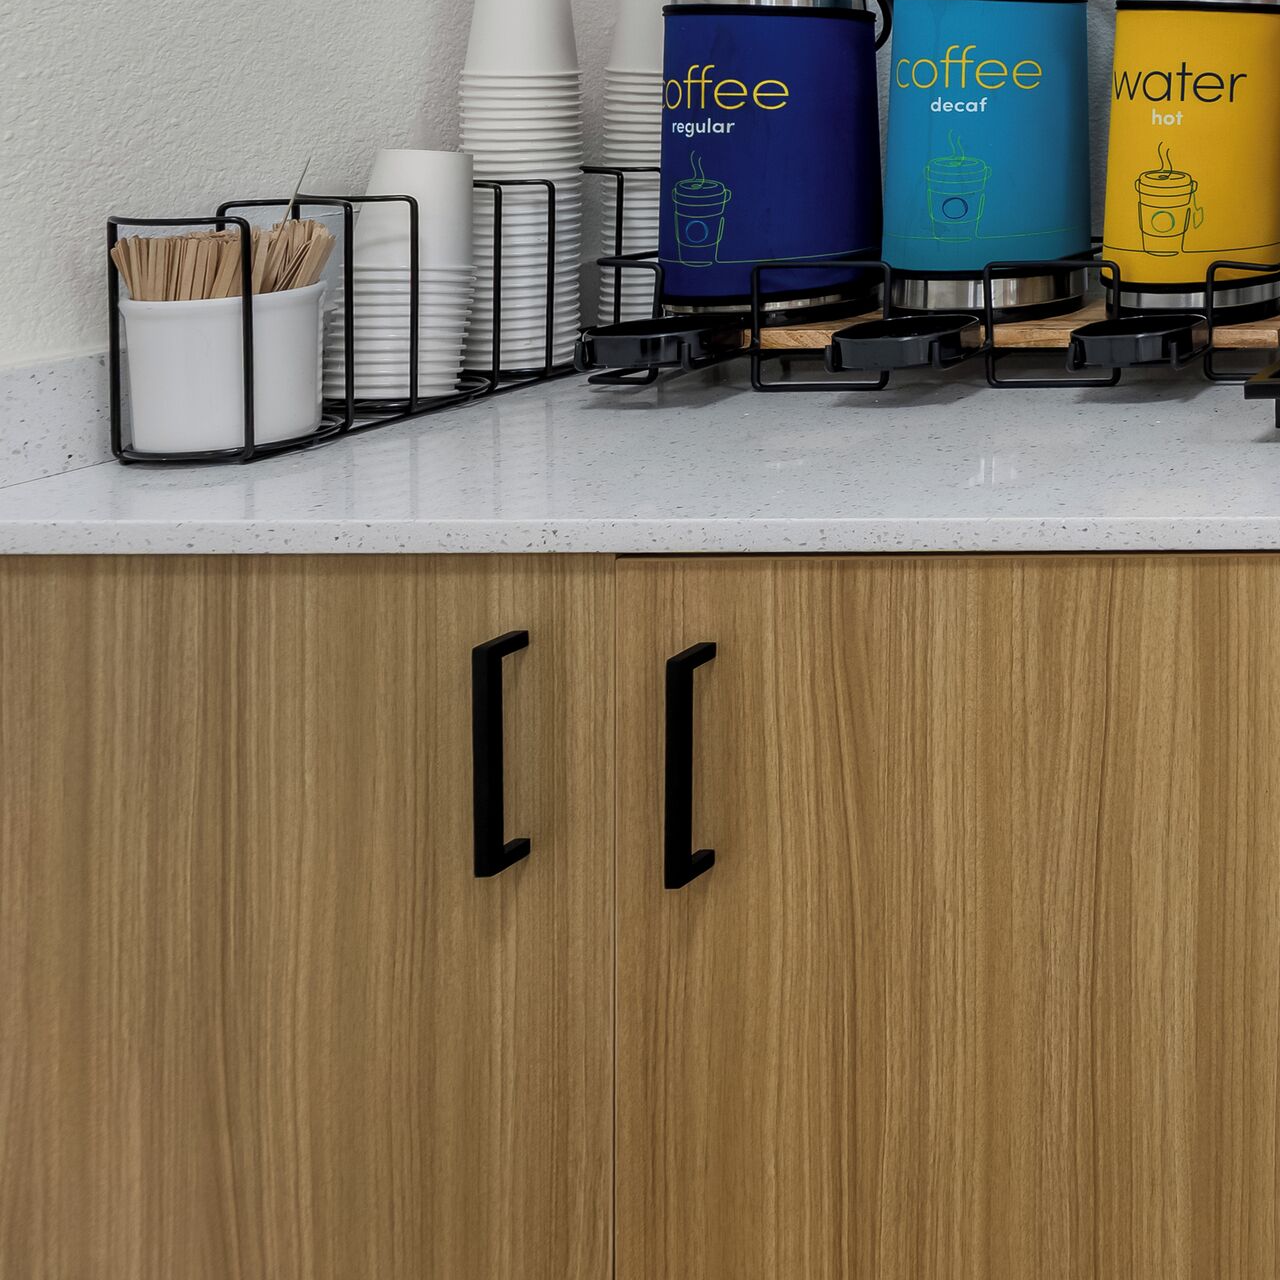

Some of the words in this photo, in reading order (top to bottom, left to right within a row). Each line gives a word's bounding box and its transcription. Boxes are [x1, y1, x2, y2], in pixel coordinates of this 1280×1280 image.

[896, 44, 1043, 89] coffee
[662, 64, 789, 110] offee
[1114, 62, 1248, 103] water
[930, 96, 988, 112] decaf
[1151, 108, 1184, 126] hot
[672, 118, 735, 137] regular
